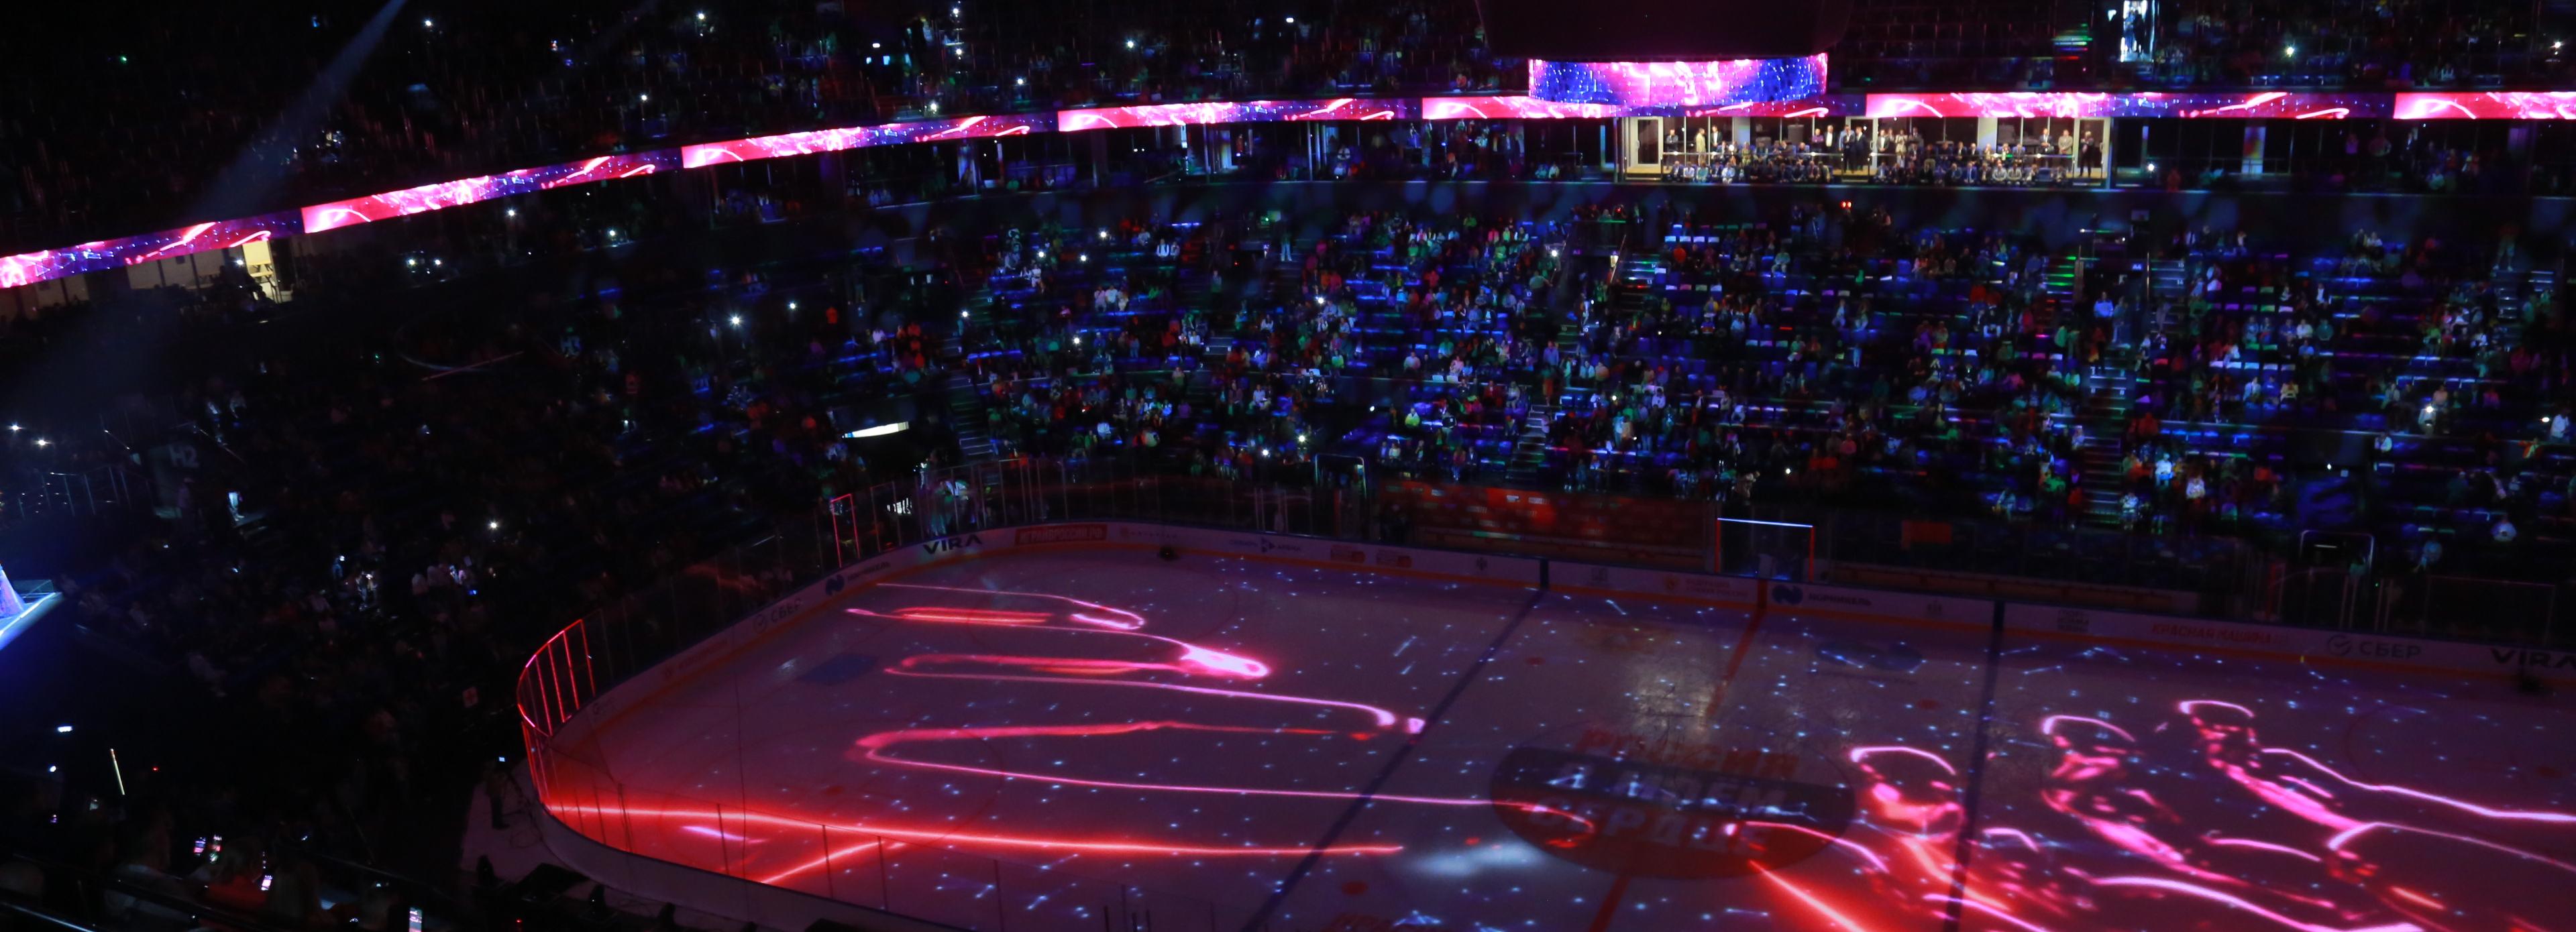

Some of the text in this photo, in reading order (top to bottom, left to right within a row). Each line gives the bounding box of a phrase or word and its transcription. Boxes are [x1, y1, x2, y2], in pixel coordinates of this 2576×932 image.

[922, 534, 983, 555] VIRA
[2359, 641, 2421, 659] СБЕР
[2490, 647, 2576, 669] VIRA
